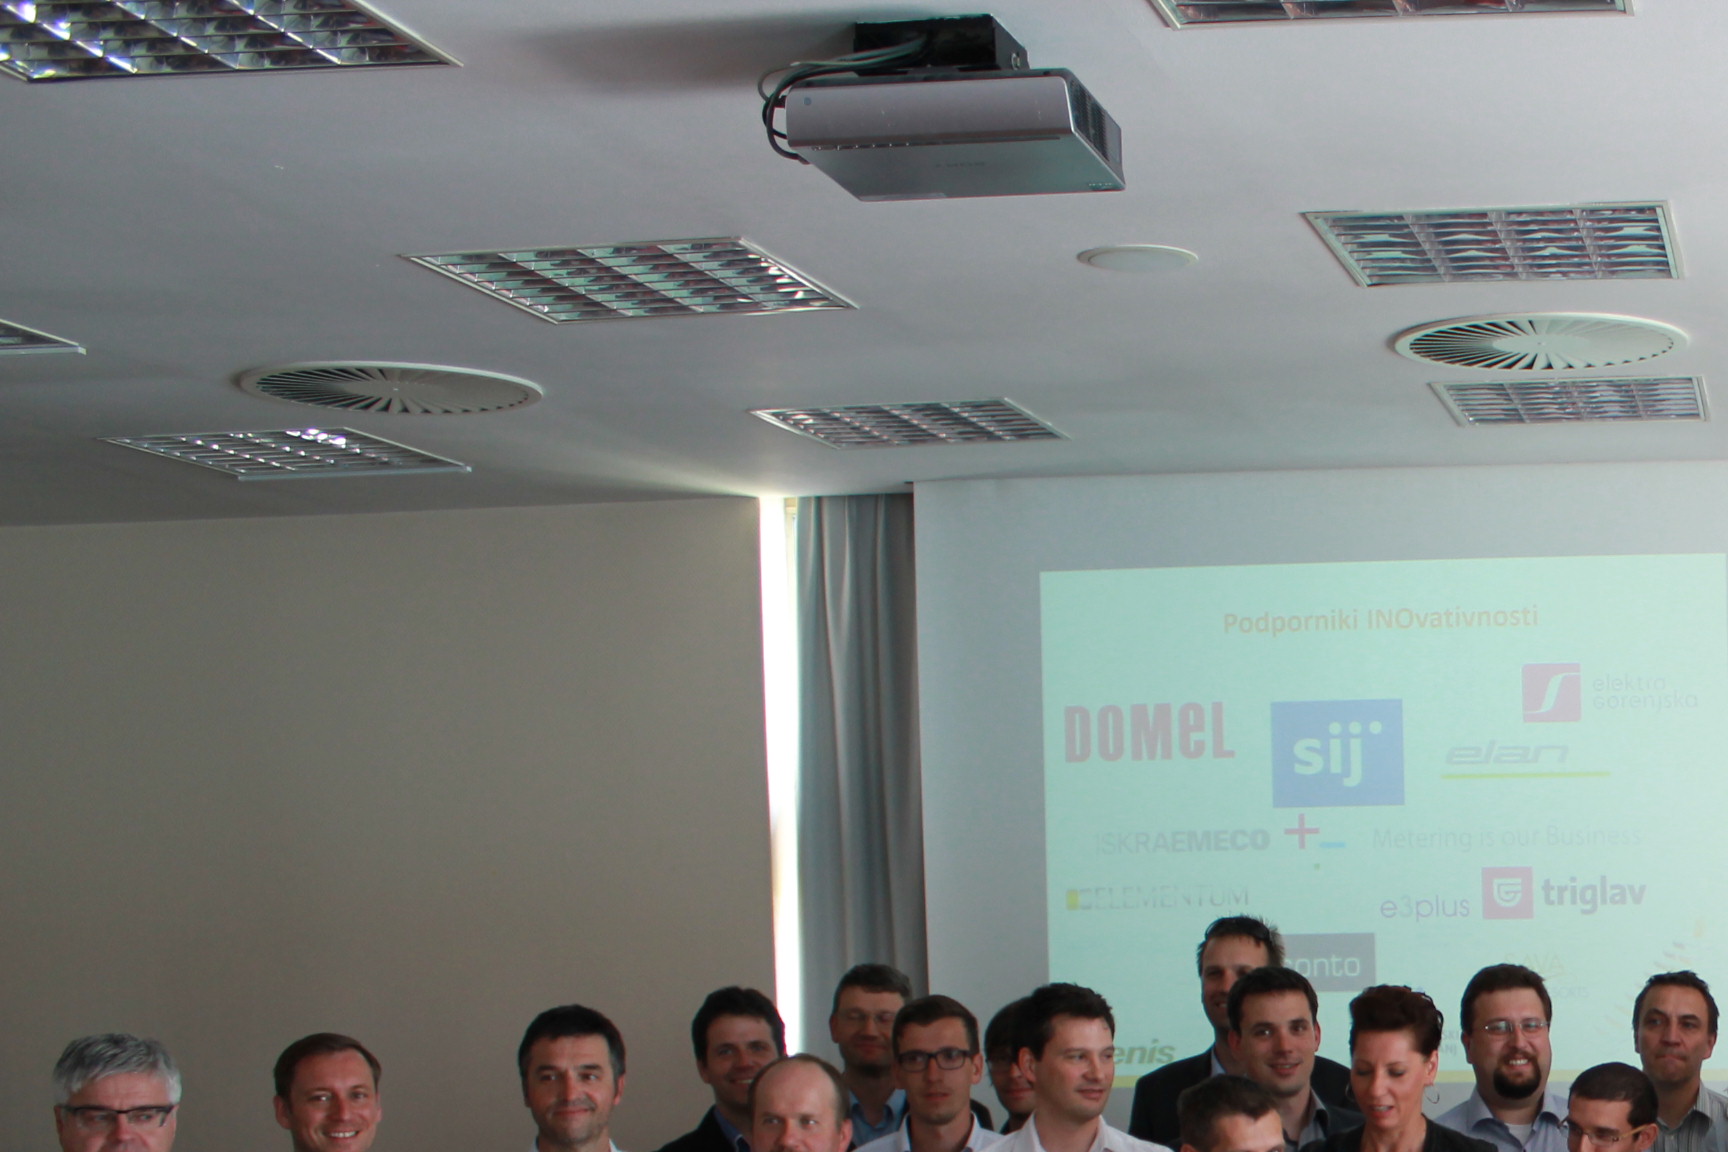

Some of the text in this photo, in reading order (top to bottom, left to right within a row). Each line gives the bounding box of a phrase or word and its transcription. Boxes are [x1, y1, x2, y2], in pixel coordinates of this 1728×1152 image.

[1223, 604, 1539, 637] Podporniki INOvativnosti
[1292, 720, 1363, 787] sij
[1444, 740, 1570, 765] elan
[1095, 828, 1271, 855] ISKRAEMECO
[1372, 823, 1642, 853] Metering is our Business
[1379, 894, 1471, 922] e3plus
[1541, 875, 1648, 914] triglav
